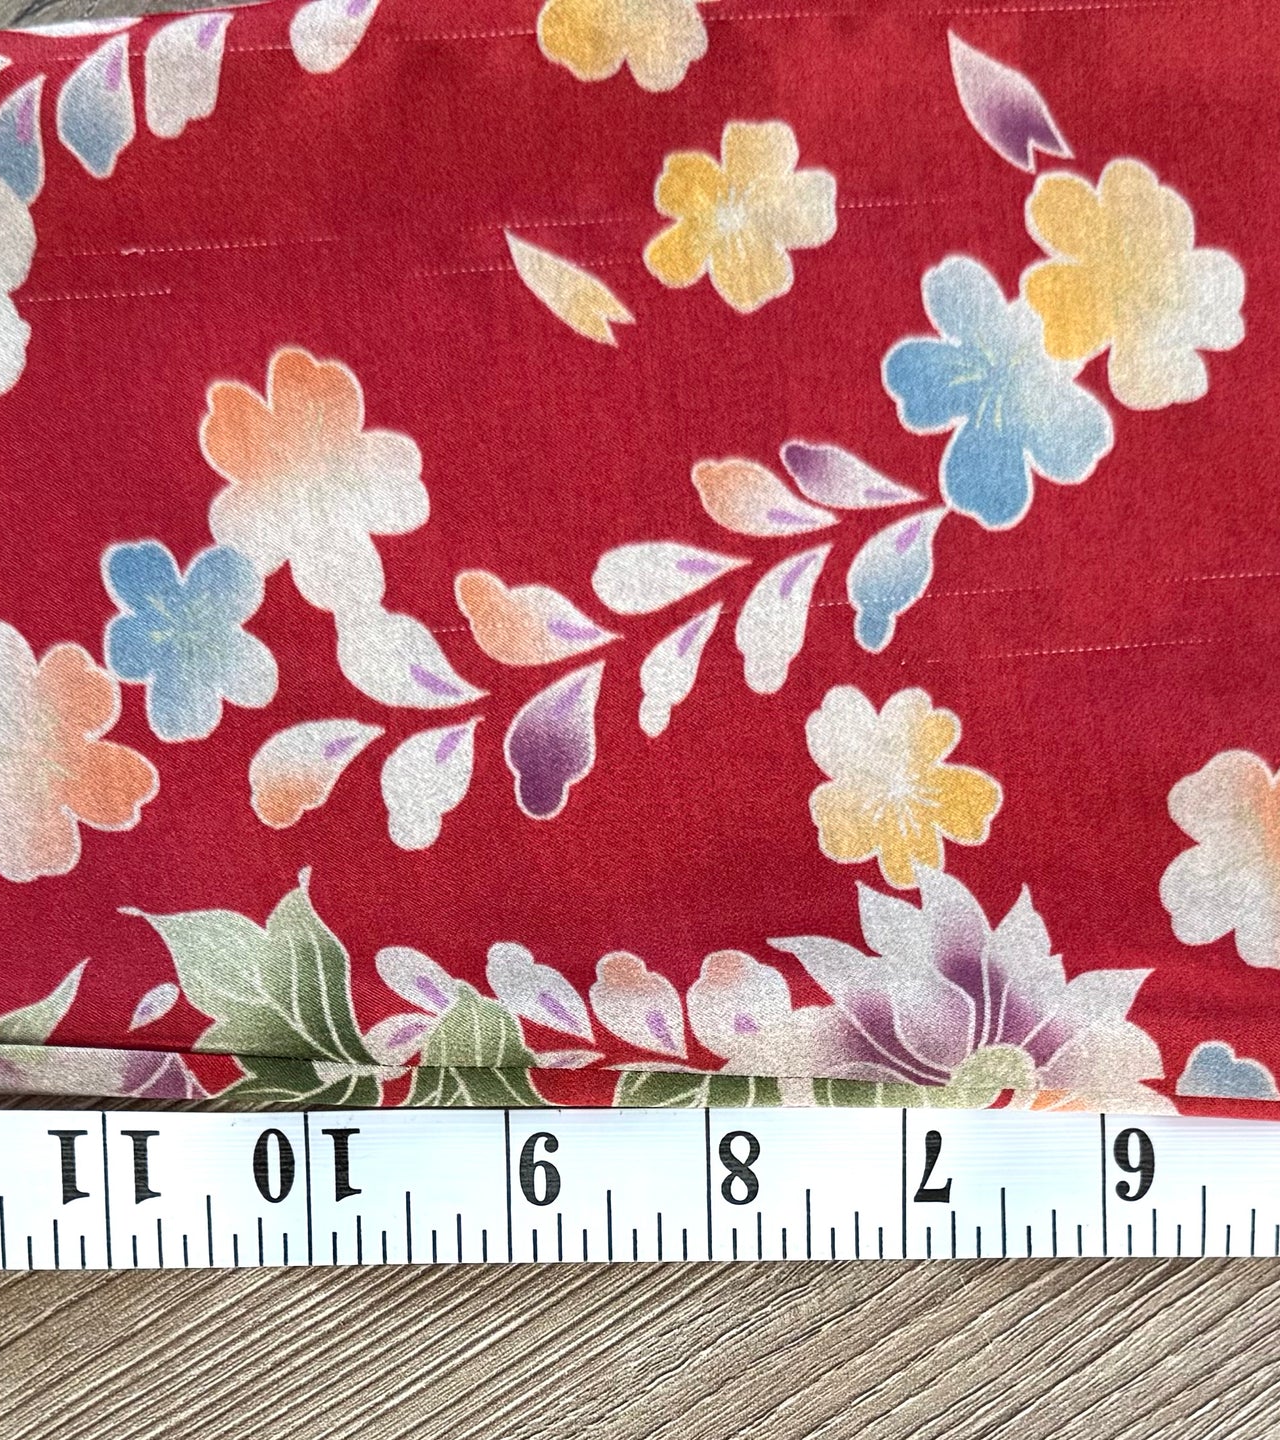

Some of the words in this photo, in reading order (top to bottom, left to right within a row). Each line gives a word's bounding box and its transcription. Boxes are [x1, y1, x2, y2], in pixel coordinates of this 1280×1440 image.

[520, 1131, 561, 1206] 9
[720, 1130, 761, 1205] 8
[914, 1130, 953, 1203] 7
[1113, 1128, 1155, 1201] 6
